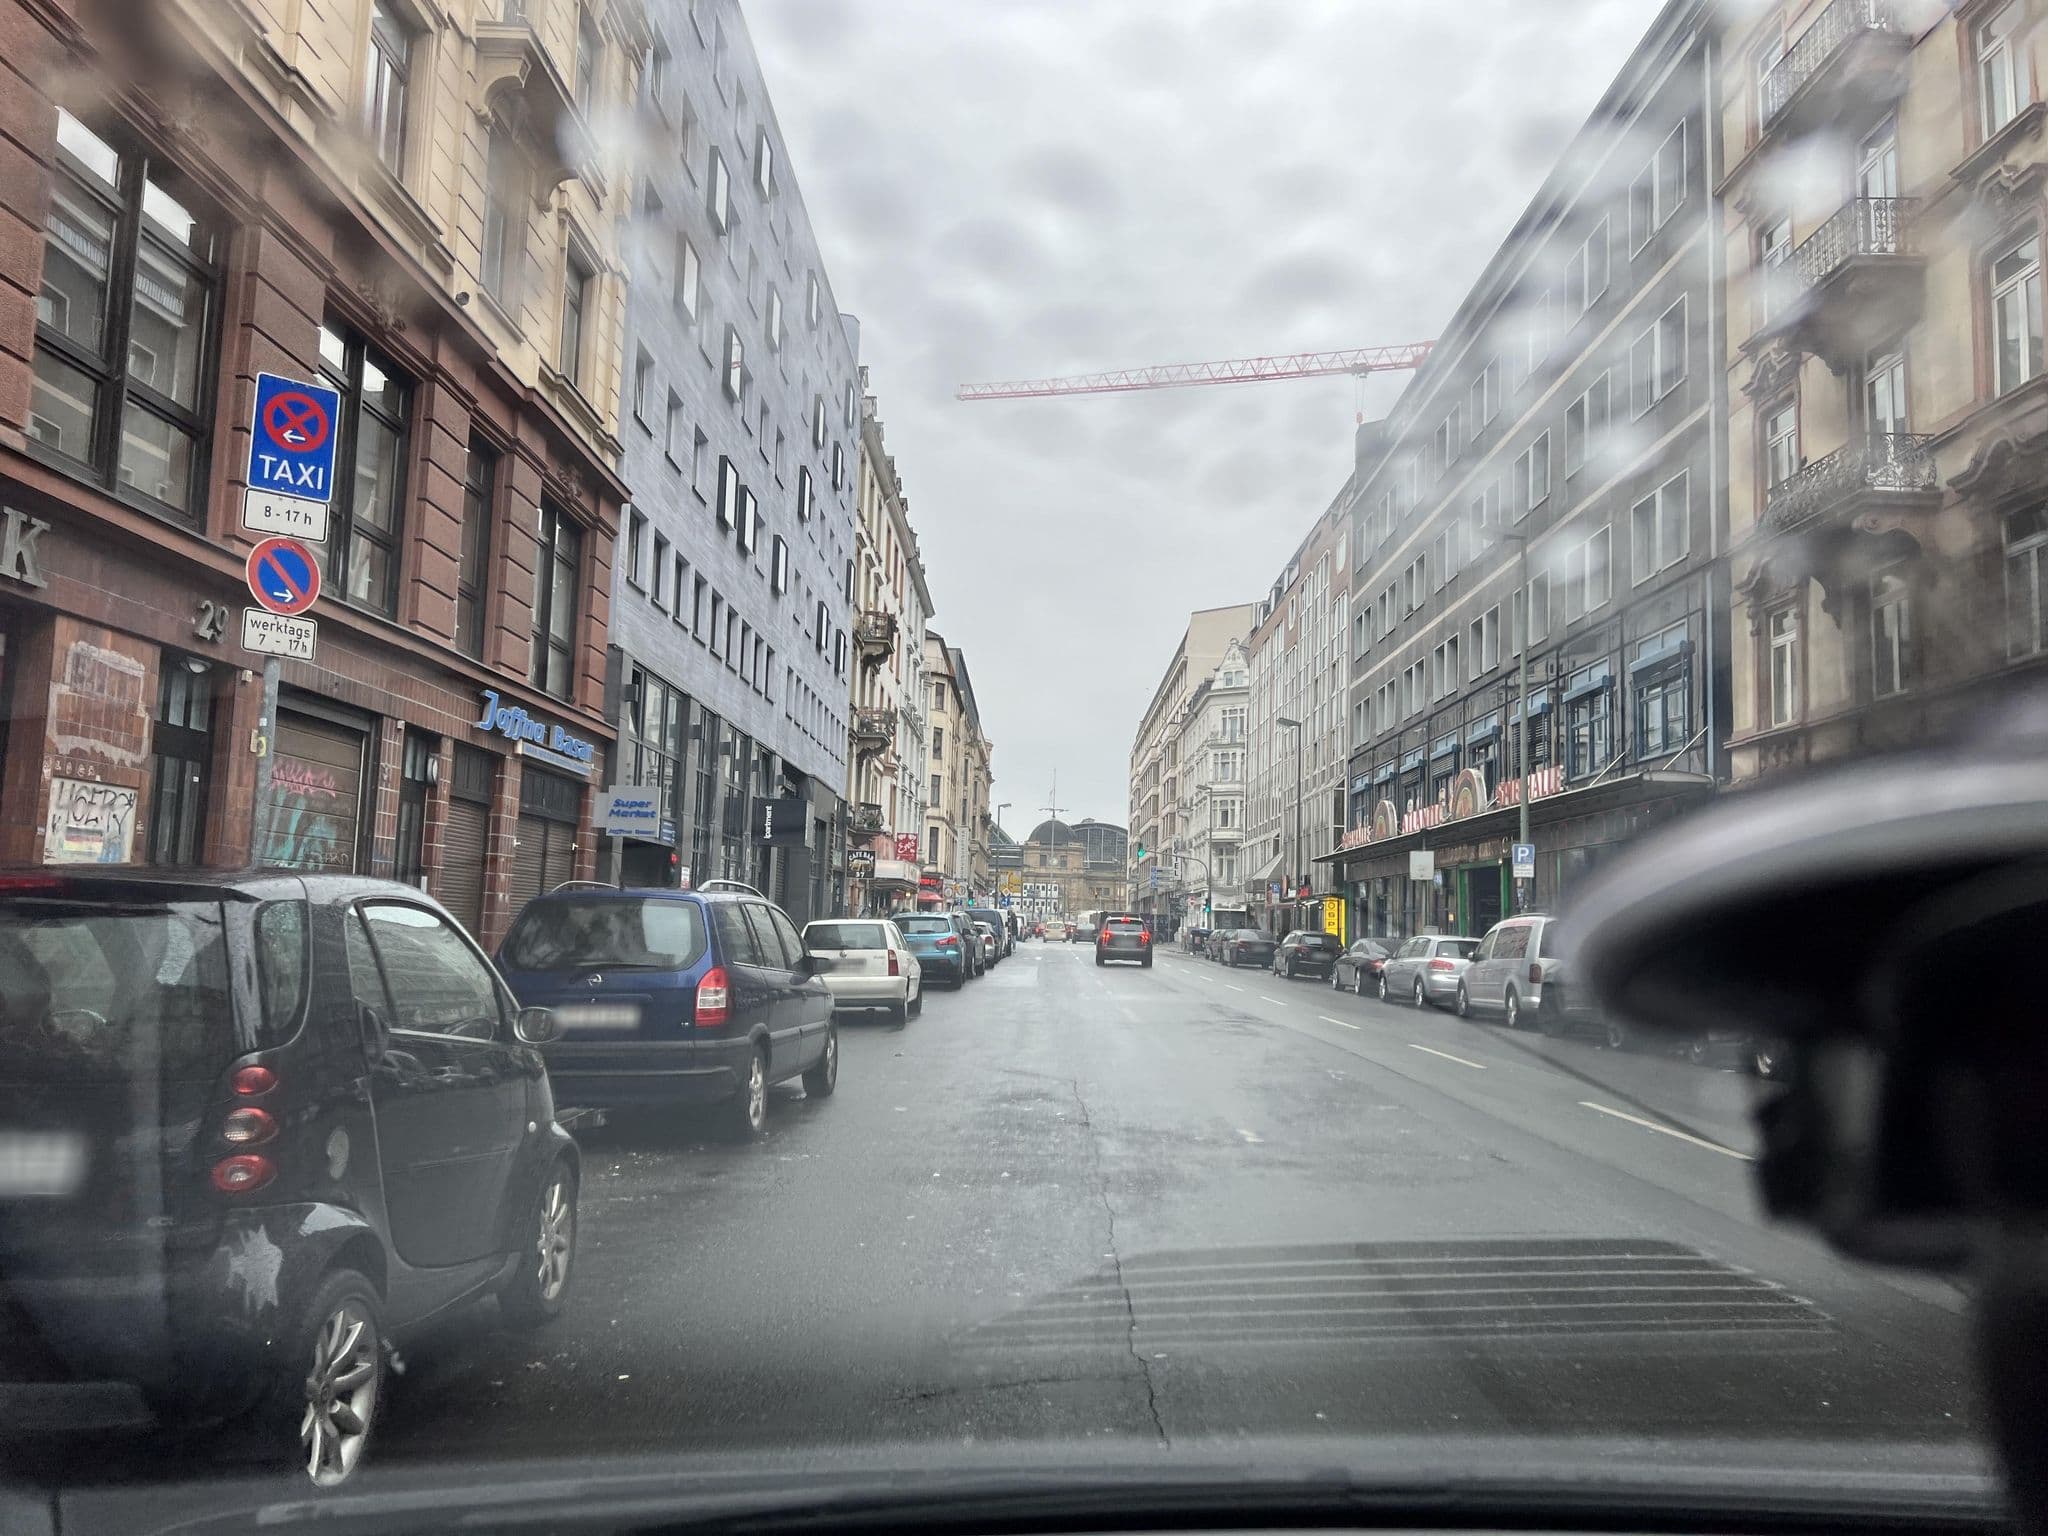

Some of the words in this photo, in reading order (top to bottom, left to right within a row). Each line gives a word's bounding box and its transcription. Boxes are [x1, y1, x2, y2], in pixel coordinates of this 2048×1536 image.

[258, 454, 324, 490] TAXI
[264, 505, 271, 518] 8
[285, 509, 300, 522] 17
[304, 513, 312, 525] h
[196, 599, 229, 643] 29
[250, 618, 311, 639] werktags
[259, 633, 266, 645] 7
[480, 689, 545, 744] Jaffna
[554, 725, 594, 762] Basar
[608, 809, 657, 818] Market
[613, 798, 652, 809] Super
